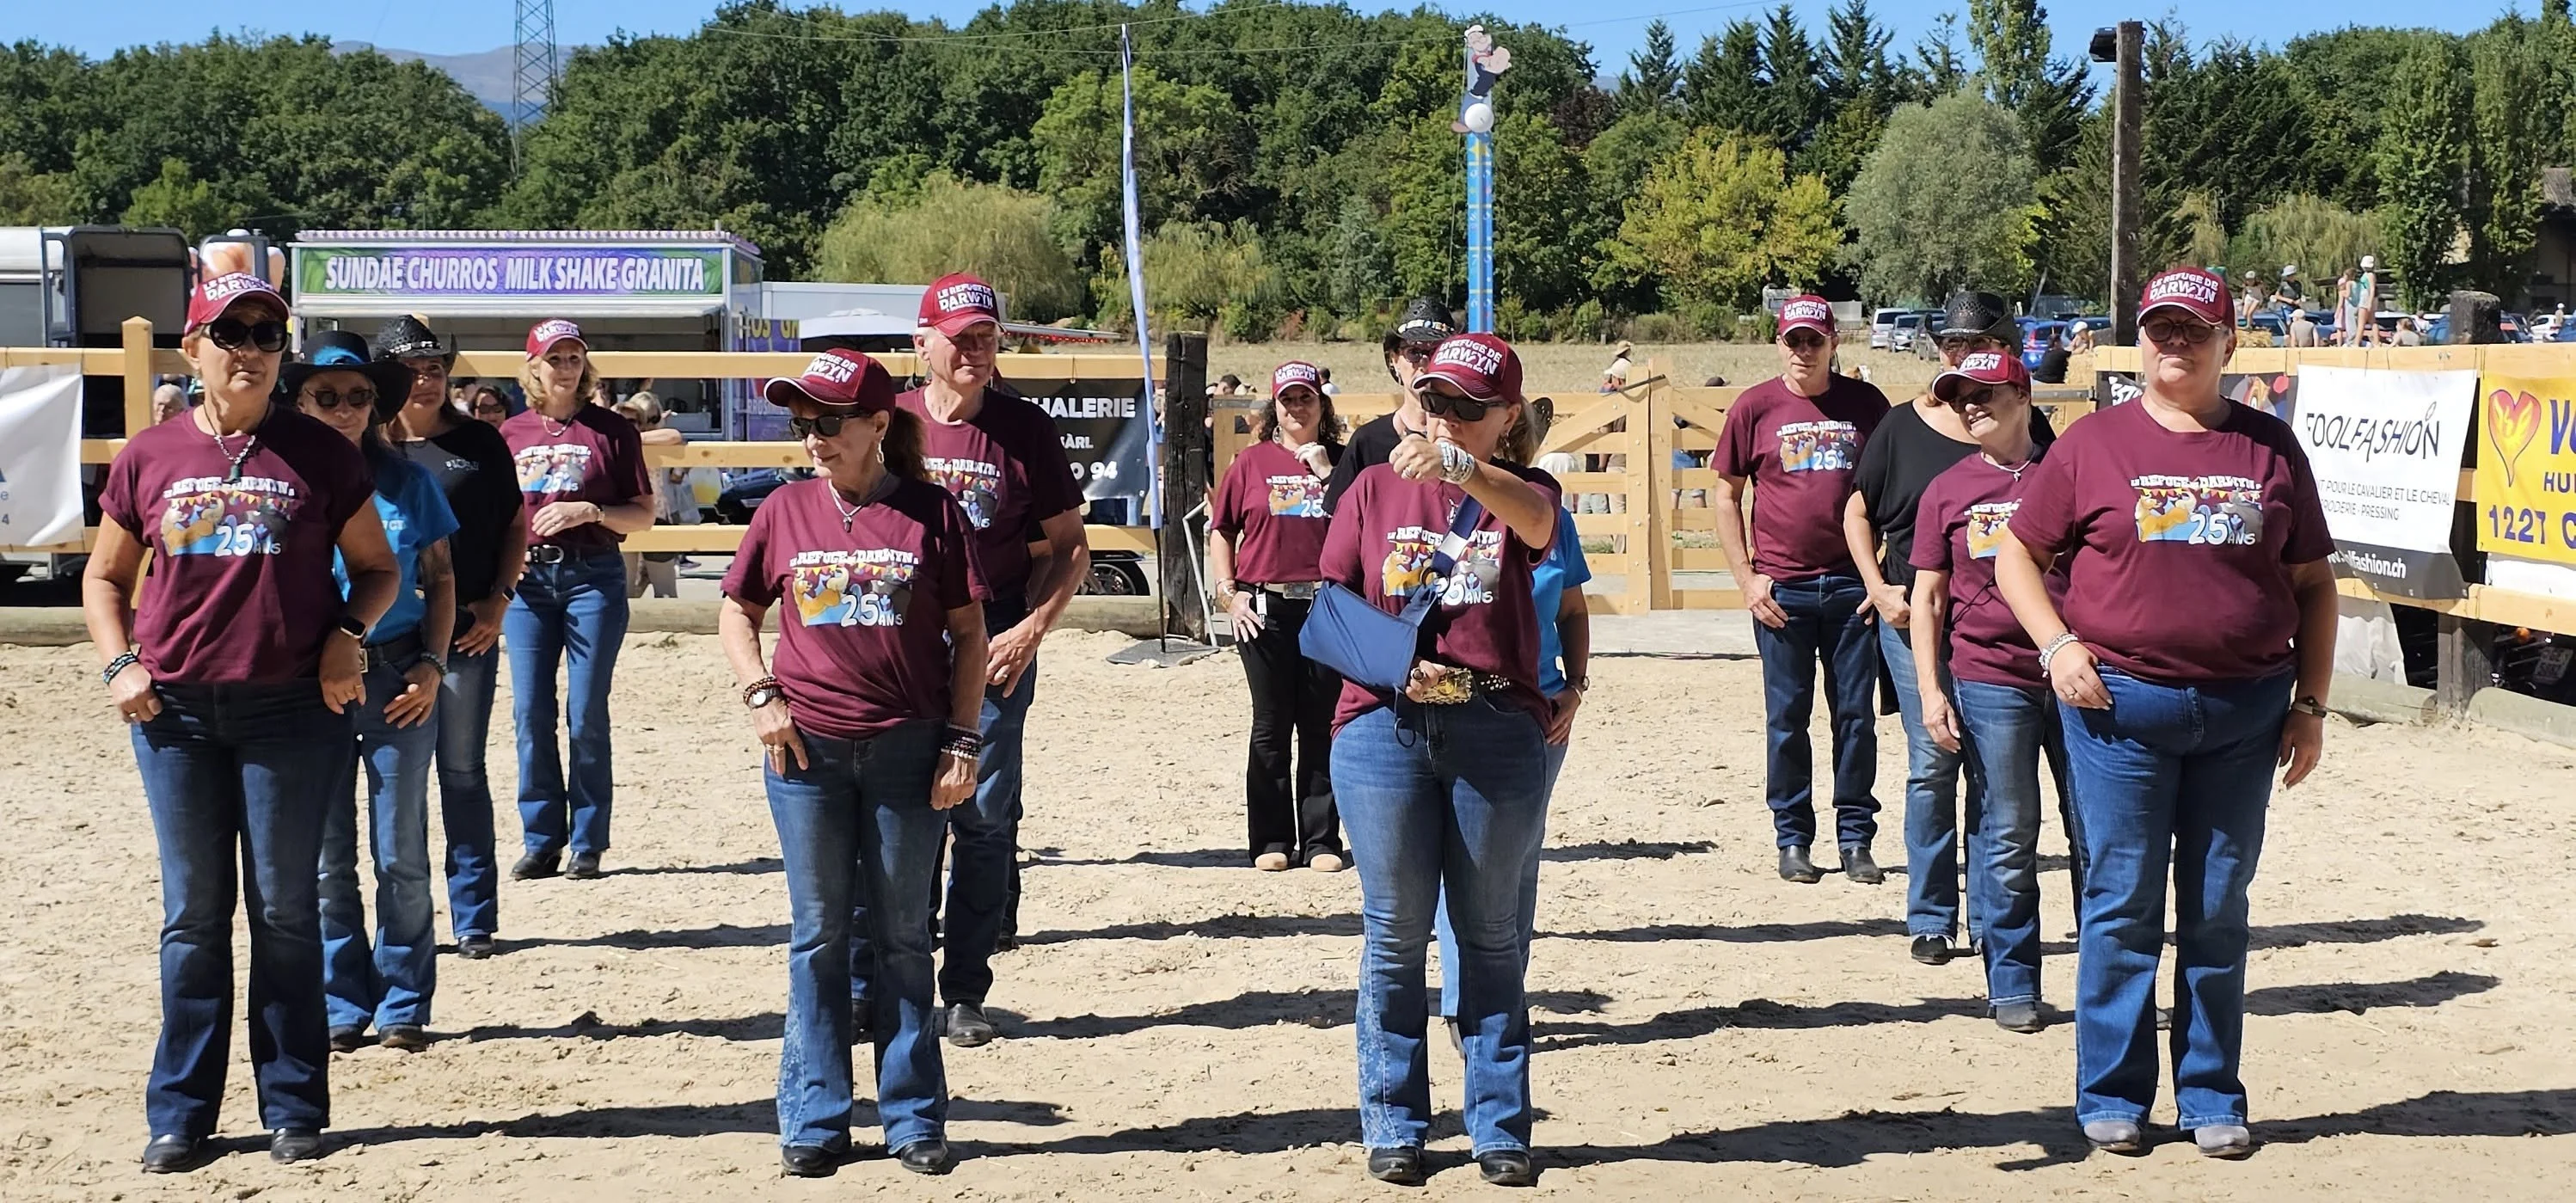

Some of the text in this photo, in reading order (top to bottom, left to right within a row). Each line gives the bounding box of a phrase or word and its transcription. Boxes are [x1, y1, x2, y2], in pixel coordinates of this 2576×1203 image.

[325, 256, 704, 291] SUNDAE CHURROS MILK SHAKE GRANITA
[2151, 272, 2218, 291] LE REFUGE DE
[936, 288, 948, 299] LE
[939, 292, 993, 310] DARWYN
[2150, 280, 2216, 303] DARWYN
[1434, 347, 1498, 375] DARWYN
[1449, 339, 1487, 353] REFUGE
[1487, 347, 1502, 363] DE
[841, 359, 858, 372] DE
[1812, 449, 1837, 470] 25
[1090, 461, 1118, 481] 94
[172, 476, 222, 495] REFUGE
[2139, 474, 2189, 487] REFUGE
[2199, 476, 2254, 489] DARWYN
[2327, 480, 2346, 494] POUR
[2347, 482, 2355, 495] LE
[2357, 483, 2393, 500] CAVALIER
[2395, 488, 2405, 500] ET
[2407, 488, 2418, 502] LE
[1301, 499, 1324, 518] 25
[2321, 499, 2400, 520] RODERIE PRESSING
[1396, 525, 1444, 545] REFUGE
[2188, 513, 2256, 545] 25 ANS
[215, 523, 255, 557] 25
[797, 550, 849, 565] REFUGE
[856, 548, 913, 564] DARWYN
[1464, 591, 1493, 604] ANS
[841, 592, 904, 628] 25 ANS
